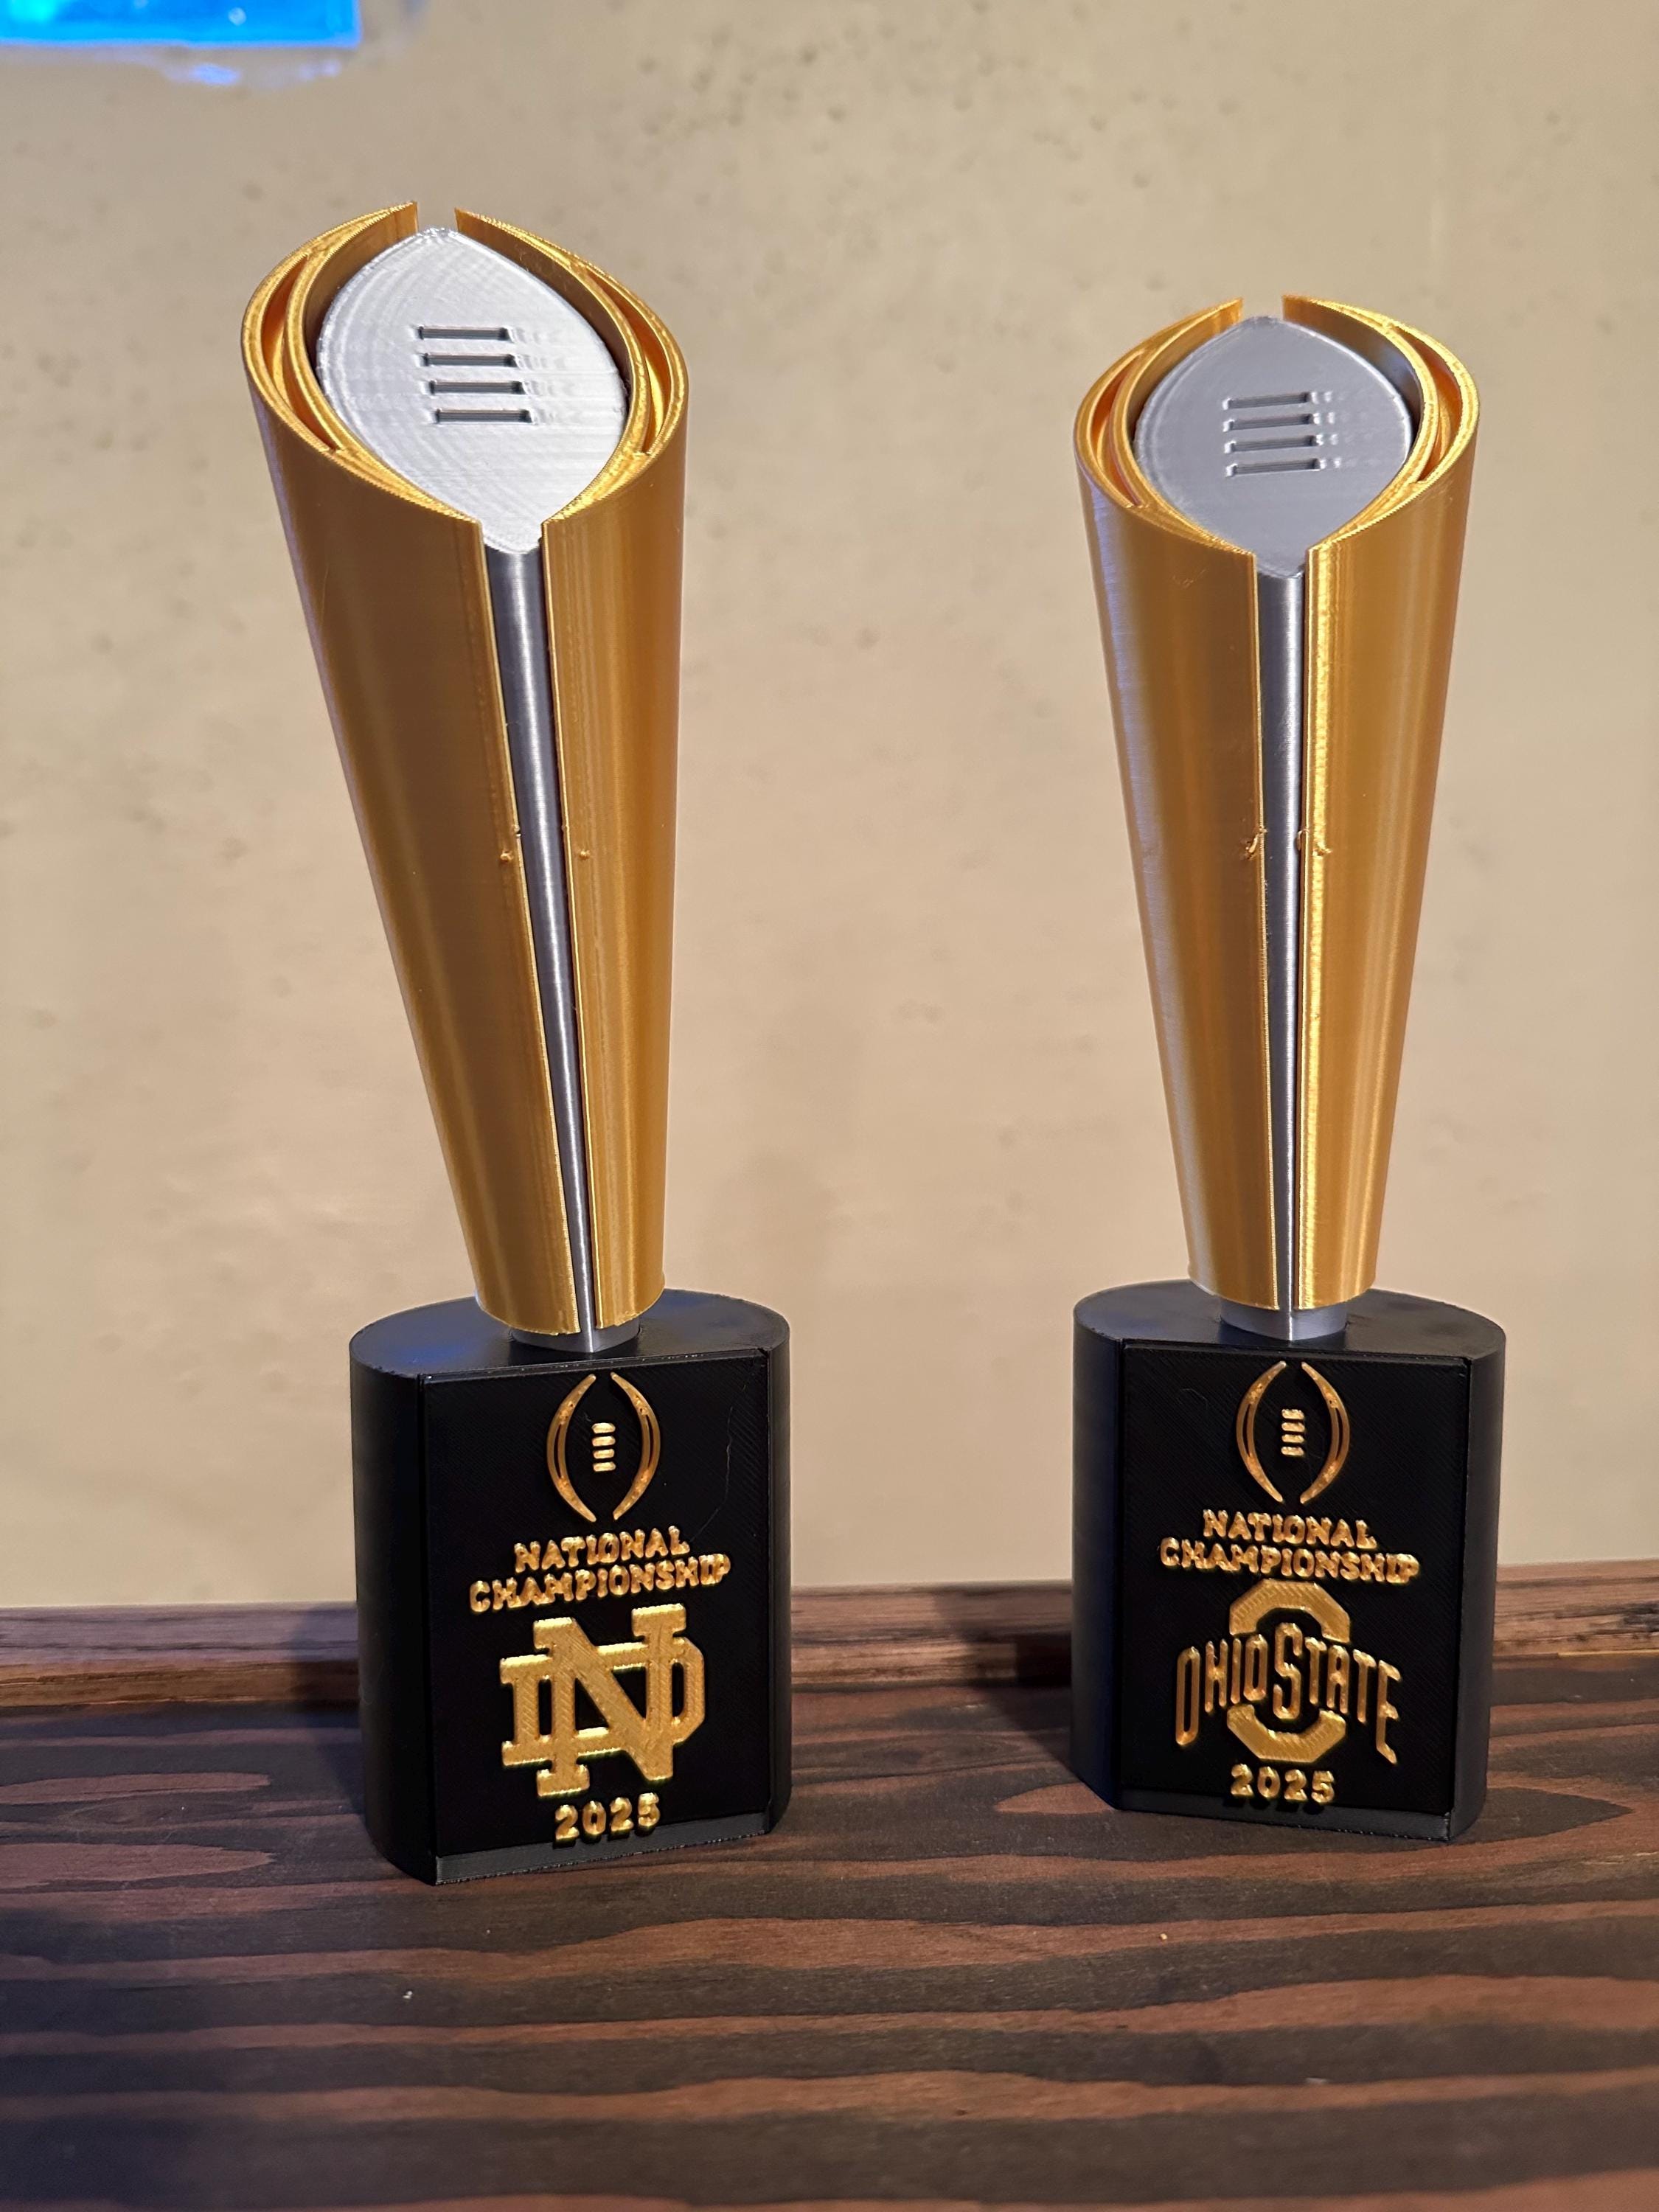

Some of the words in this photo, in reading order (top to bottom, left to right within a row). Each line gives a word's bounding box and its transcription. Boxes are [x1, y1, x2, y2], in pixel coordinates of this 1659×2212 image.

[515, 1526, 690, 1573] NATIONAL
[1203, 1509, 1377, 1549] NATIONAL
[470, 1554, 731, 1613] CHAMPIONSHIP
[1160, 1537, 1419, 1583] CHAMPIONSHIP
[1175, 1633, 1268, 1745] OHIO
[1273, 1623, 1401, 1764] STATE
[1231, 1764, 1335, 1804] 2025
[555, 1792, 661, 1840] 2025
